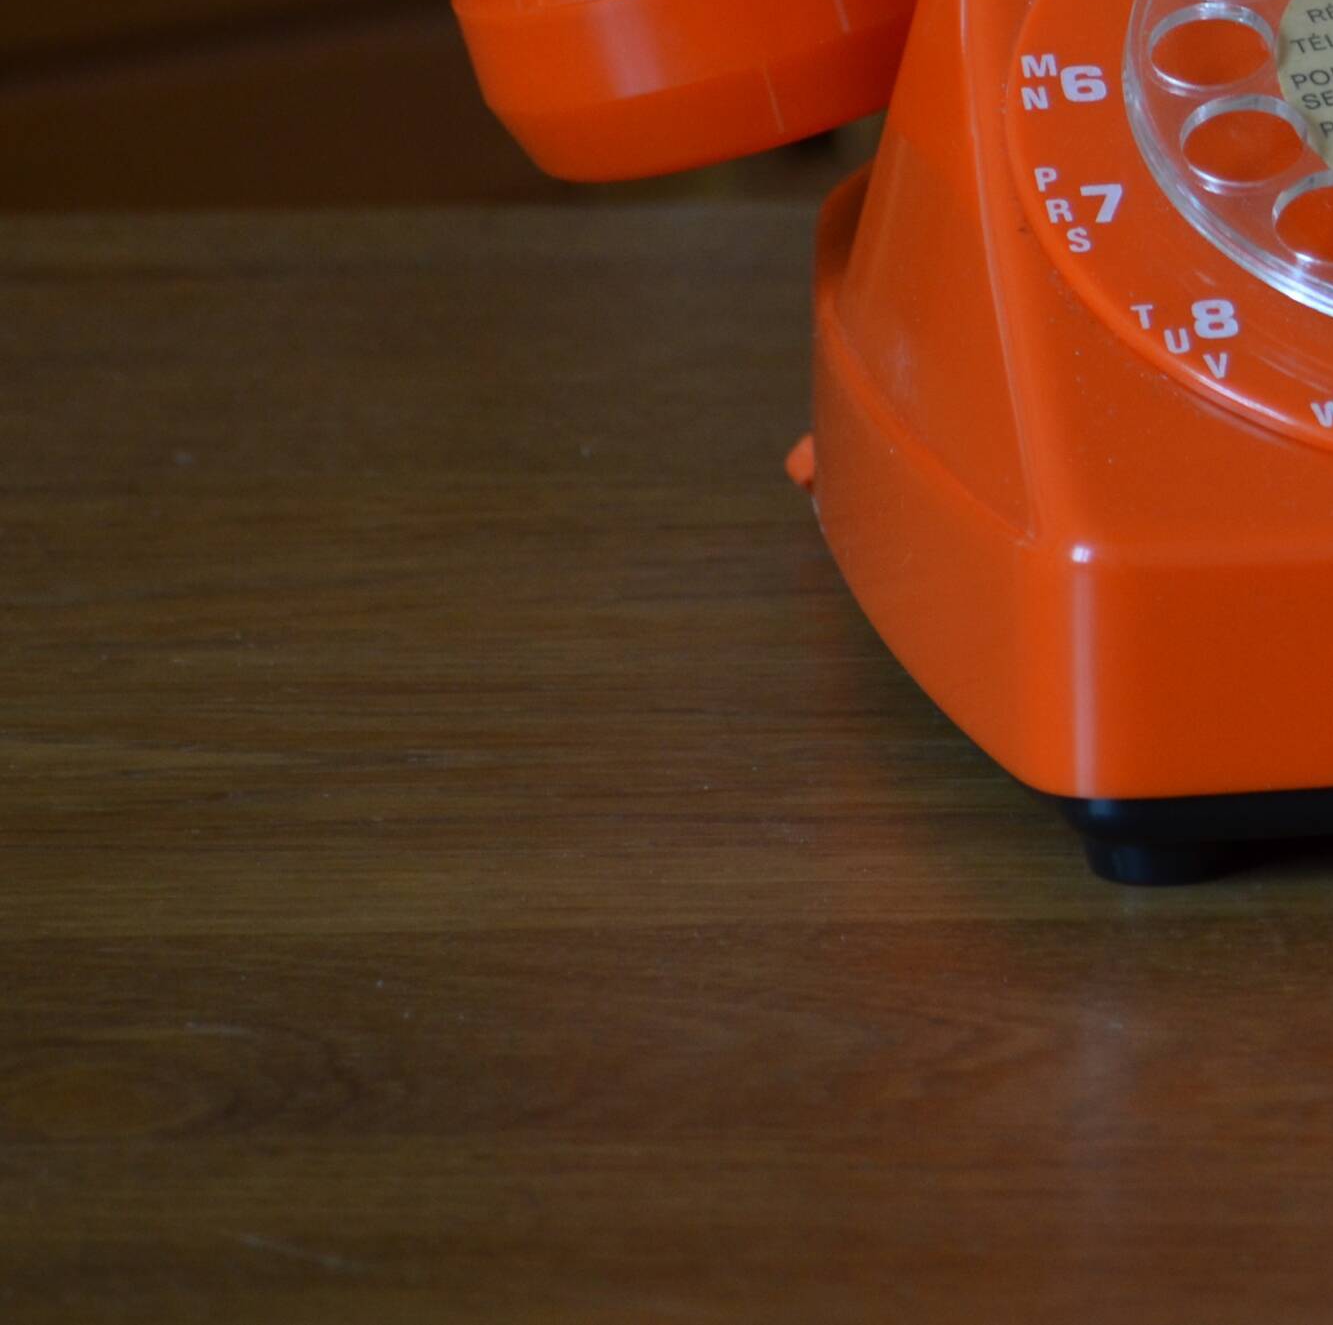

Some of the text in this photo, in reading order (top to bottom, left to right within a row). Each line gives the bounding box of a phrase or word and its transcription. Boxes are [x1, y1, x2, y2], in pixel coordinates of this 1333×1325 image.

[1060, 65, 1107, 102] 6
[1080, 184, 1123, 223] 7
[1191, 299, 1239, 339] 8
